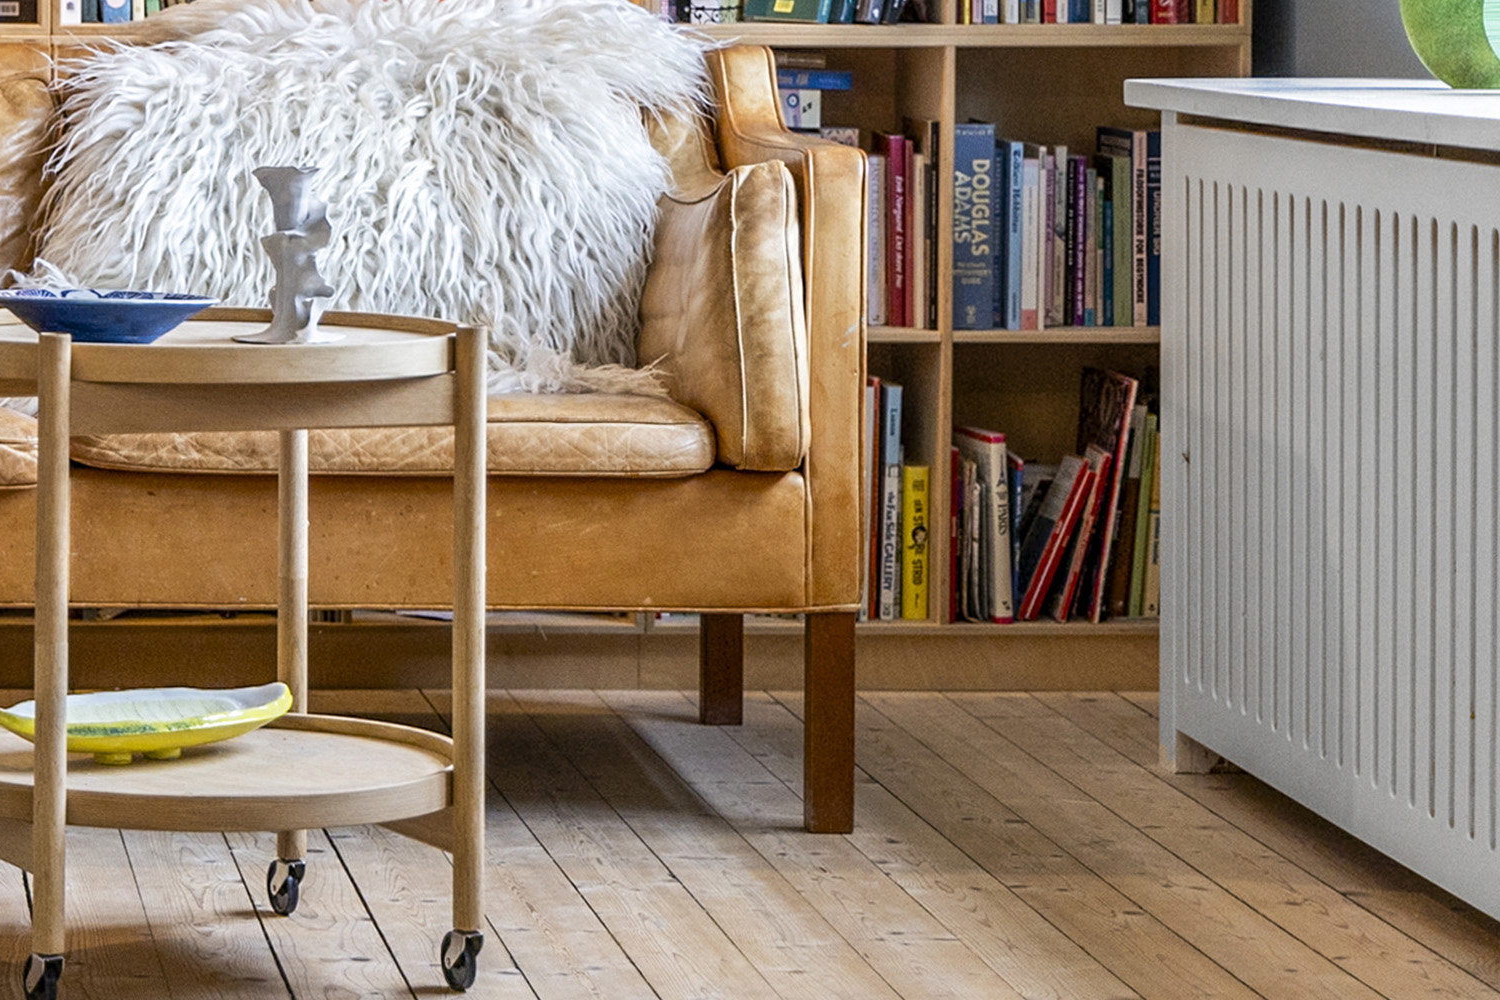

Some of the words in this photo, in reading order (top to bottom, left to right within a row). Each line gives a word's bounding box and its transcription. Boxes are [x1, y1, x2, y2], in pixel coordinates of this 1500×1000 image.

[953, 170, 971, 244] ADAMS
[971, 158, 990, 256] DOUGLAS
[997, 503, 1008, 536] PARIS
[882, 543, 894, 591] GALLERY
